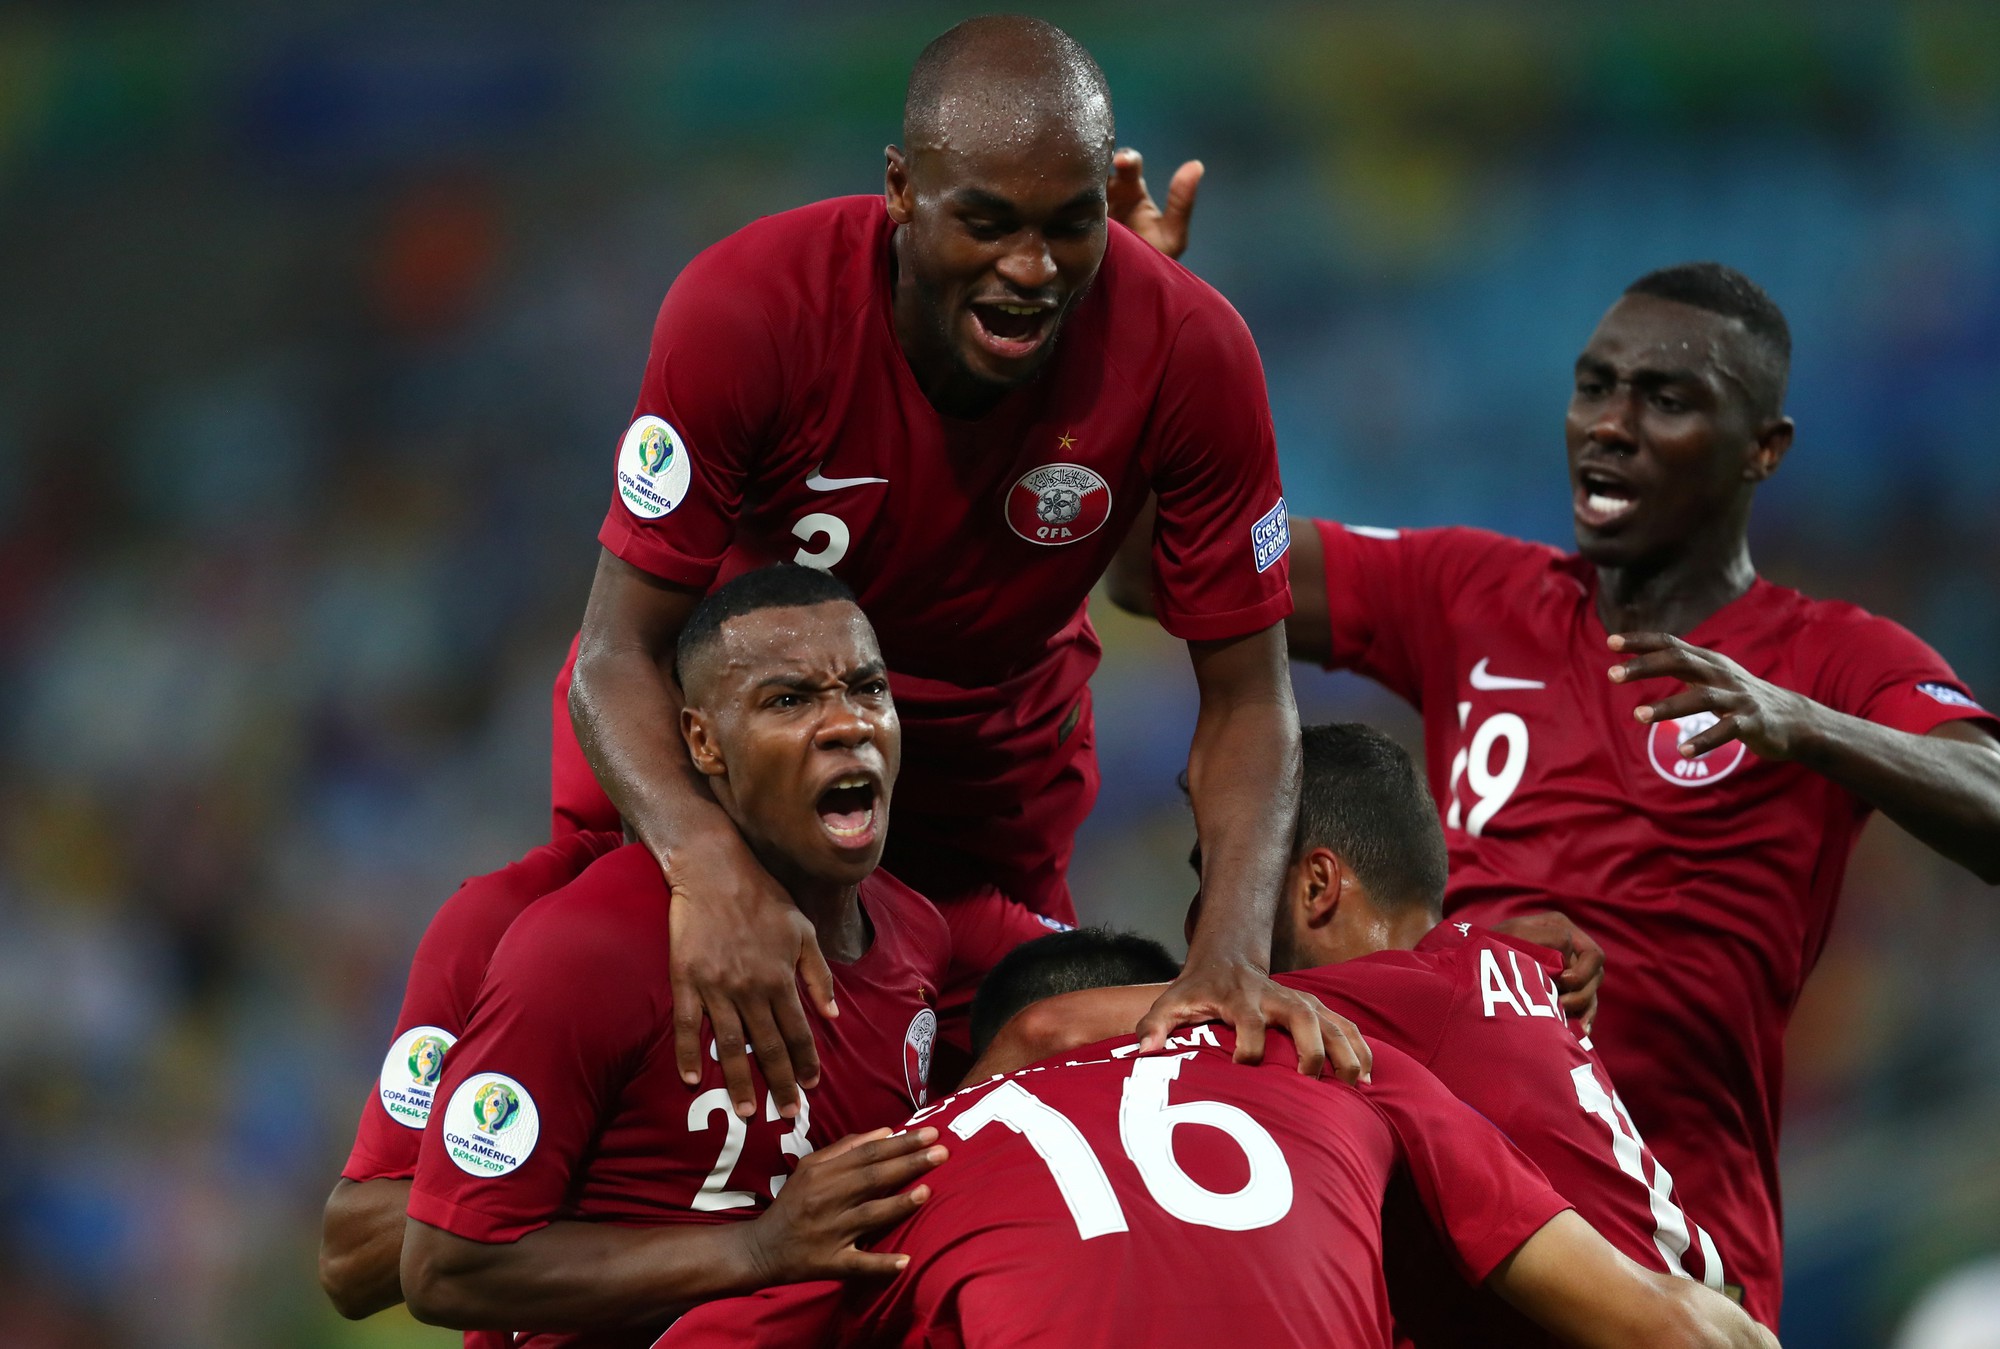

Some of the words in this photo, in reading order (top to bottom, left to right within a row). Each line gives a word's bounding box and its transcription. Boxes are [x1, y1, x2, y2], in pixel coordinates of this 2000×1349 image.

[619, 470, 635, 489] COPA
[635, 484, 671, 509] AMERICA
[643, 501, 661, 514] 2019
[1036, 526, 1073, 539] QFA
[1255, 519, 1276, 545] Cree
[1276, 508, 1286, 527] en
[1258, 526, 1287, 566] grande
[1673, 759, 1709, 778] QFA
[382, 1089, 407, 1103] COPA
[407, 1096, 433, 1110] AME
[446, 1132, 470, 1149] COPA
[470, 1143, 517, 1166] AMERICA
[687, 1082, 815, 1212] 23
[947, 1050, 1294, 1241] 16
[483, 1159, 505, 1172] 2019
